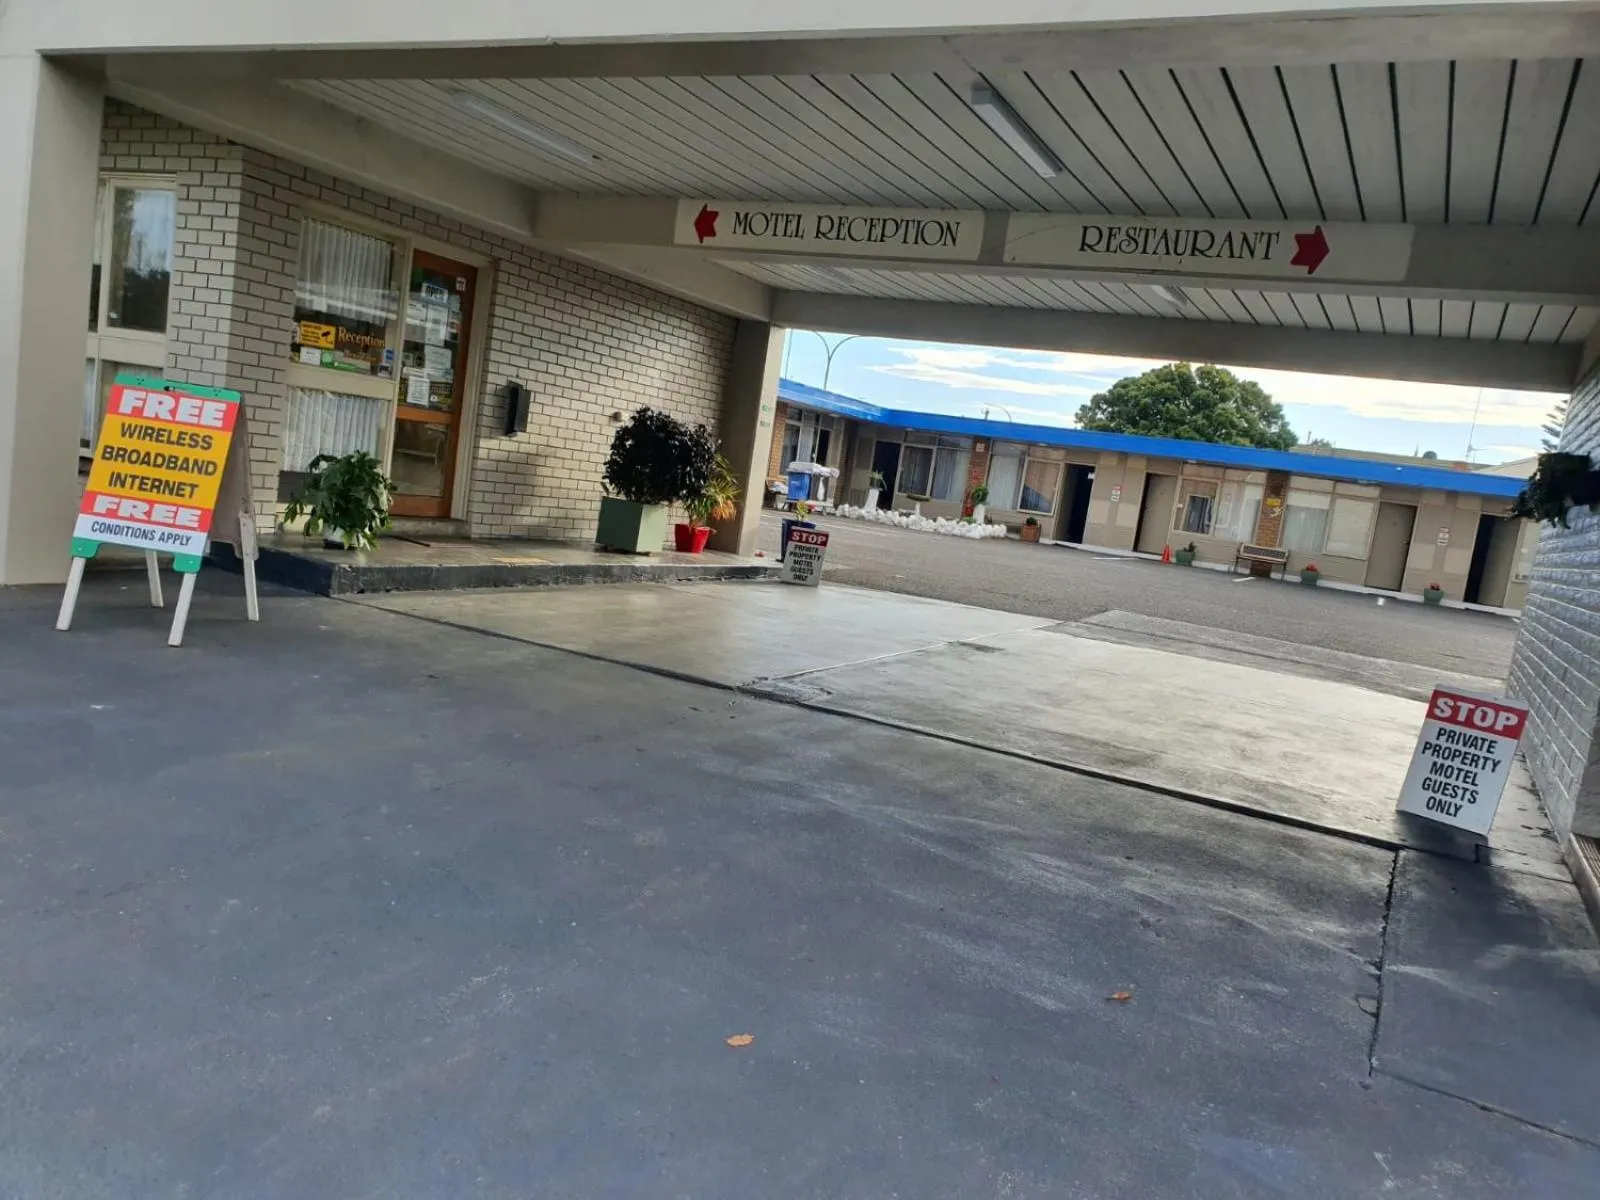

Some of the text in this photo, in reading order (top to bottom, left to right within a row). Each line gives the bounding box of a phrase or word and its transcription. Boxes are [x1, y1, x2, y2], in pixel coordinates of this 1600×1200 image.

[732, 211, 960, 247] MOTEL RECEPTION
[1079, 224, 1280, 260] RESTAURANT
[338, 325, 385, 348] Reception
[118, 388, 227, 428] FREE
[120, 422, 213, 451] WIRELESS
[101, 445, 217, 477] BROADBAND
[108, 471, 199, 499] INTERNET
[92, 494, 202, 528] FREE
[91, 521, 192, 546] CONDITIONS APPLY
[791, 531, 827, 545] STOP
[1433, 697, 1519, 731] STOP
[1435, 727, 1498, 755] PRIVATE
[1422, 741, 1502, 773] PROPERTY
[1429, 761, 1480, 787] MOTEL
[1422, 777, 1480, 804] GUESTS
[1426, 795, 1464, 818] ONLY
